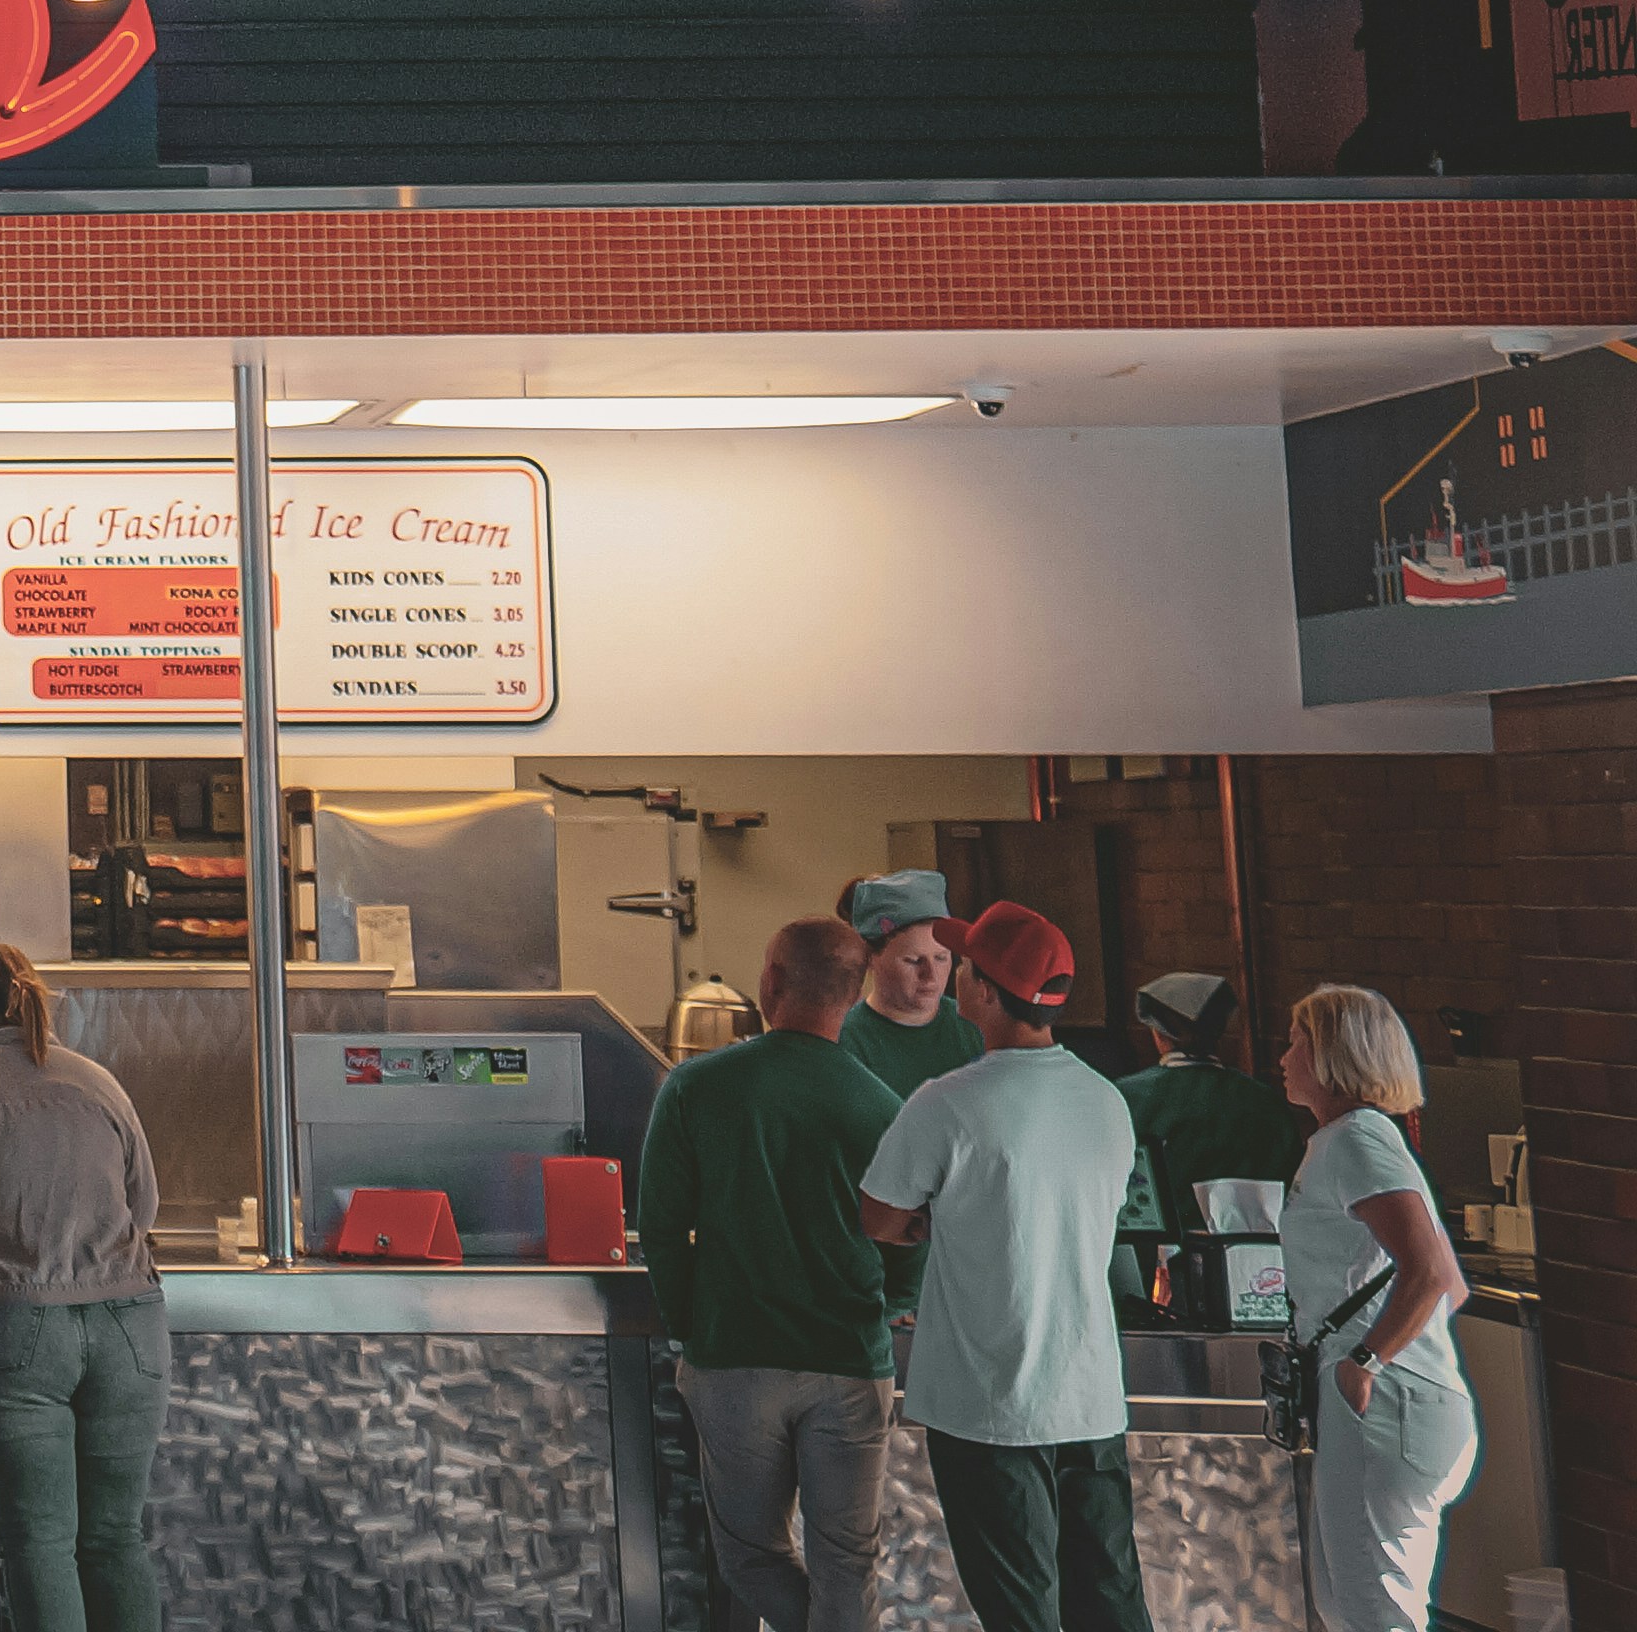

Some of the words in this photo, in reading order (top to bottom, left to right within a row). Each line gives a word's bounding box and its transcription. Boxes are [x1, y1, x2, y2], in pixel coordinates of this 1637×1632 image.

[6, 504, 77, 551] Old
[95, 499, 294, 548] Fashiond
[309, 505, 365, 539] Ice
[391, 507, 511, 550] Cream
[59, 556, 86, 566] ICE
[94, 556, 150, 566] CREAM
[159, 556, 229, 566] FLAVORS
[16, 574, 67, 585] VANILLA
[330, 571, 374, 585] KIDS
[384, 571, 444, 585] CONES
[492, 572, 521, 585] 2.20
[14, 590, 86, 601] CHOCOLATE
[170, 588, 213, 599] KONA
[15, 607, 96, 618] STRAWBERRY
[184, 606, 228, 618] ROCKY
[331, 608, 396, 622] SINGLE
[406, 608, 466, 622] CONES
[494, 608, 523, 622] 3.05
[17, 623, 56, 635] MAPLE
[62, 622, 86, 634] NUT
[130, 622, 159, 632] MINT
[165, 622, 236, 633] CHOCOLATE
[69, 646, 132, 657] SUNDAE
[140, 646, 222, 657] TOPPINGS
[332, 644, 406, 658] DOUBLE
[416, 644, 477, 658] SCOOP
[496, 643, 524, 657] 4.25
[49, 665, 74, 676] HOT
[79, 665, 118, 676] FUDGE
[50, 684, 142, 695] BUTTERSCOTCH
[333, 681, 417, 695] SUNDAES
[497, 681, 526, 695] 3.50
